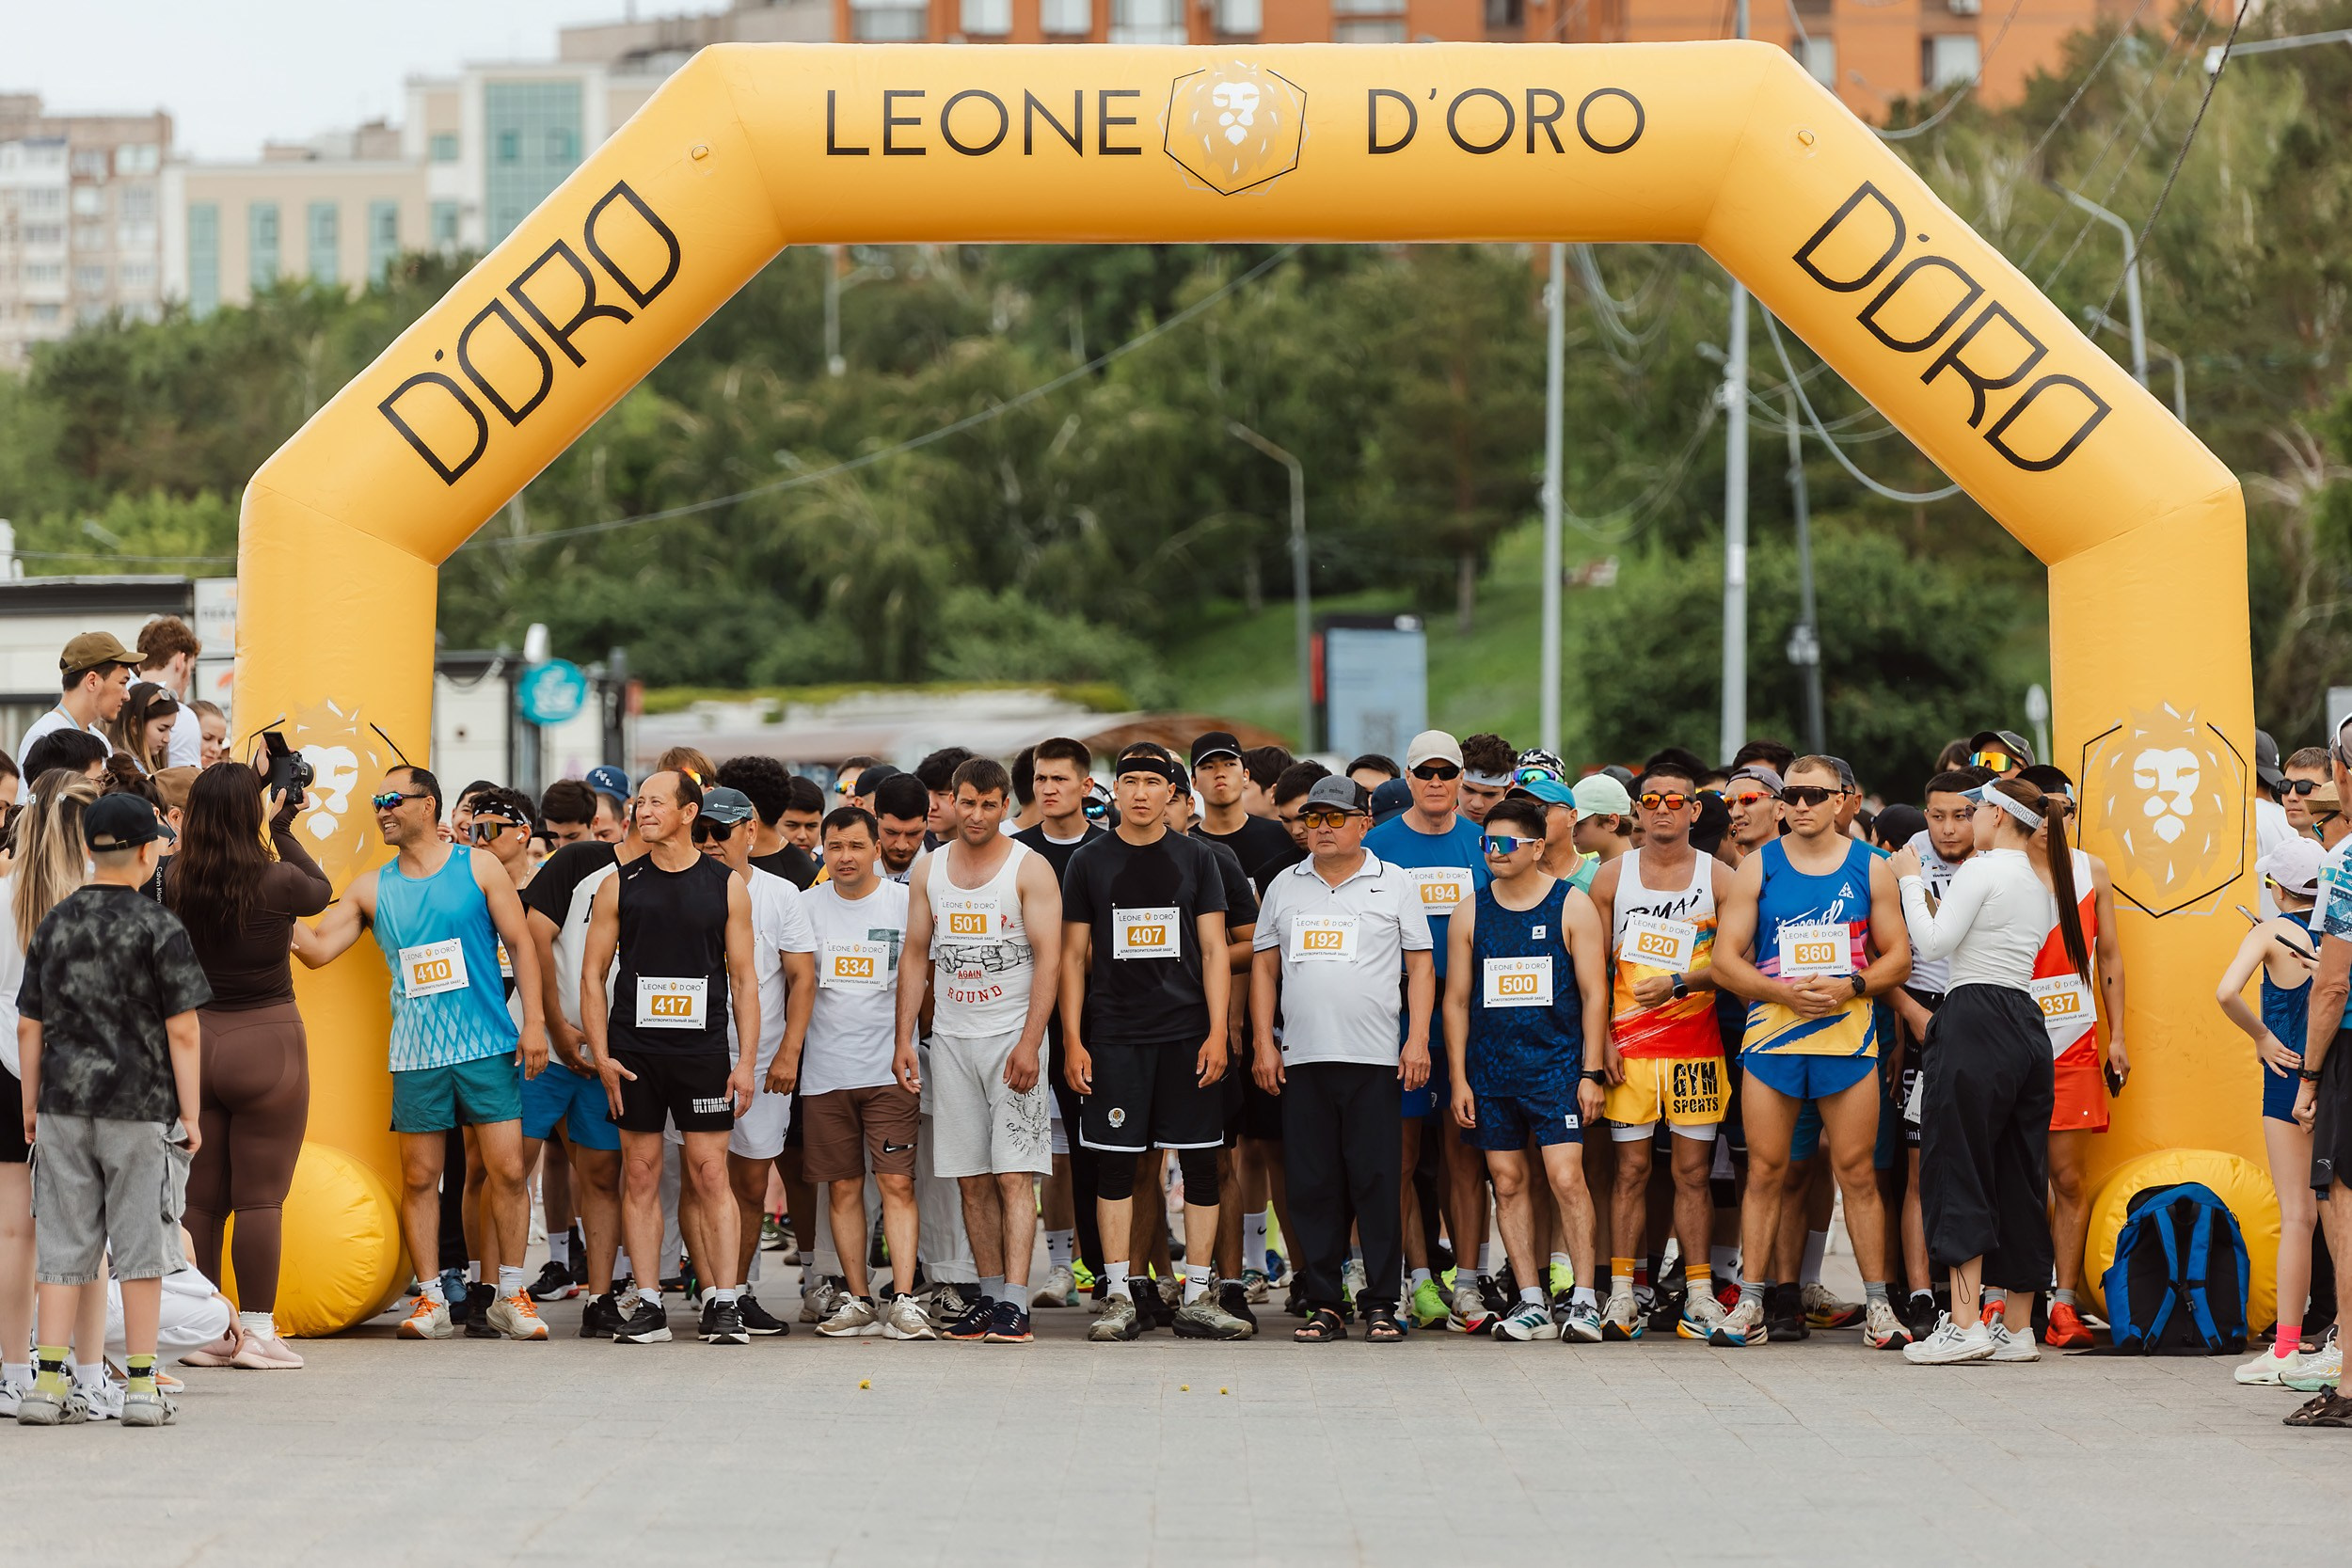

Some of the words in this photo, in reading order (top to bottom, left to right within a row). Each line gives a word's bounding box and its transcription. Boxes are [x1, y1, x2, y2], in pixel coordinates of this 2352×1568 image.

[826, 87, 1143, 157] LEONE
[1367, 87, 1645, 155] D'ORO
[377, 179, 681, 486] D'ORO
[1791, 180, 2112, 471] D'ORO
[2007, 800, 2042, 828] CHRISTIAN
[1424, 885, 1456, 901] 194
[953, 915, 981, 931] 501
[1633, 919, 1658, 929] LEONE
[1131, 927, 1162, 944] 407
[1308, 932, 1339, 947] 192
[828, 944, 850, 953] LEONE
[1642, 935, 1675, 955] 320
[1798, 944, 1831, 962] 360
[405, 952, 423, 961] LEONE
[417, 961, 448, 981] 410
[838, 958, 870, 975] 334
[958, 969, 982, 979] AGAIN
[1489, 963, 1513, 972] LEONE
[1502, 975, 1534, 993] 500
[2030, 984, 2051, 993] EONE
[947, 985, 1003, 1004] ROUND
[655, 997, 689, 1014] 417
[2042, 994, 2074, 1014] 337
[1673, 1060, 1718, 1098] GYM
[1673, 1097, 1719, 1114] SPORTS
